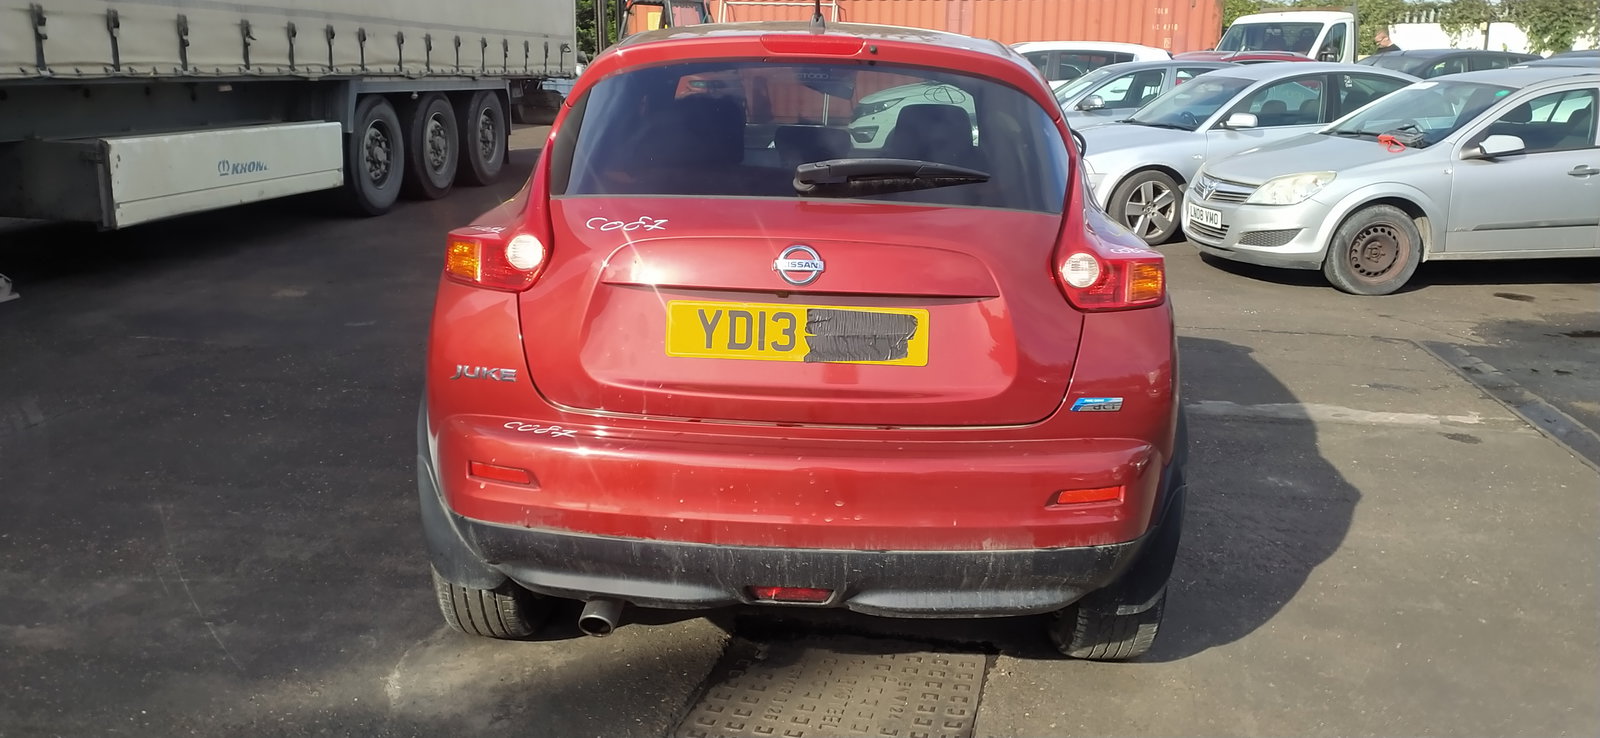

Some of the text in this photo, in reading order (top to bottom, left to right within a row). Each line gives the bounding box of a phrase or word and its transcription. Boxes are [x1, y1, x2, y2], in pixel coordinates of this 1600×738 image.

[780, 260, 819, 269] ISSAN
[697, 309, 797, 352] YD13
[450, 364, 517, 382] JUKE
